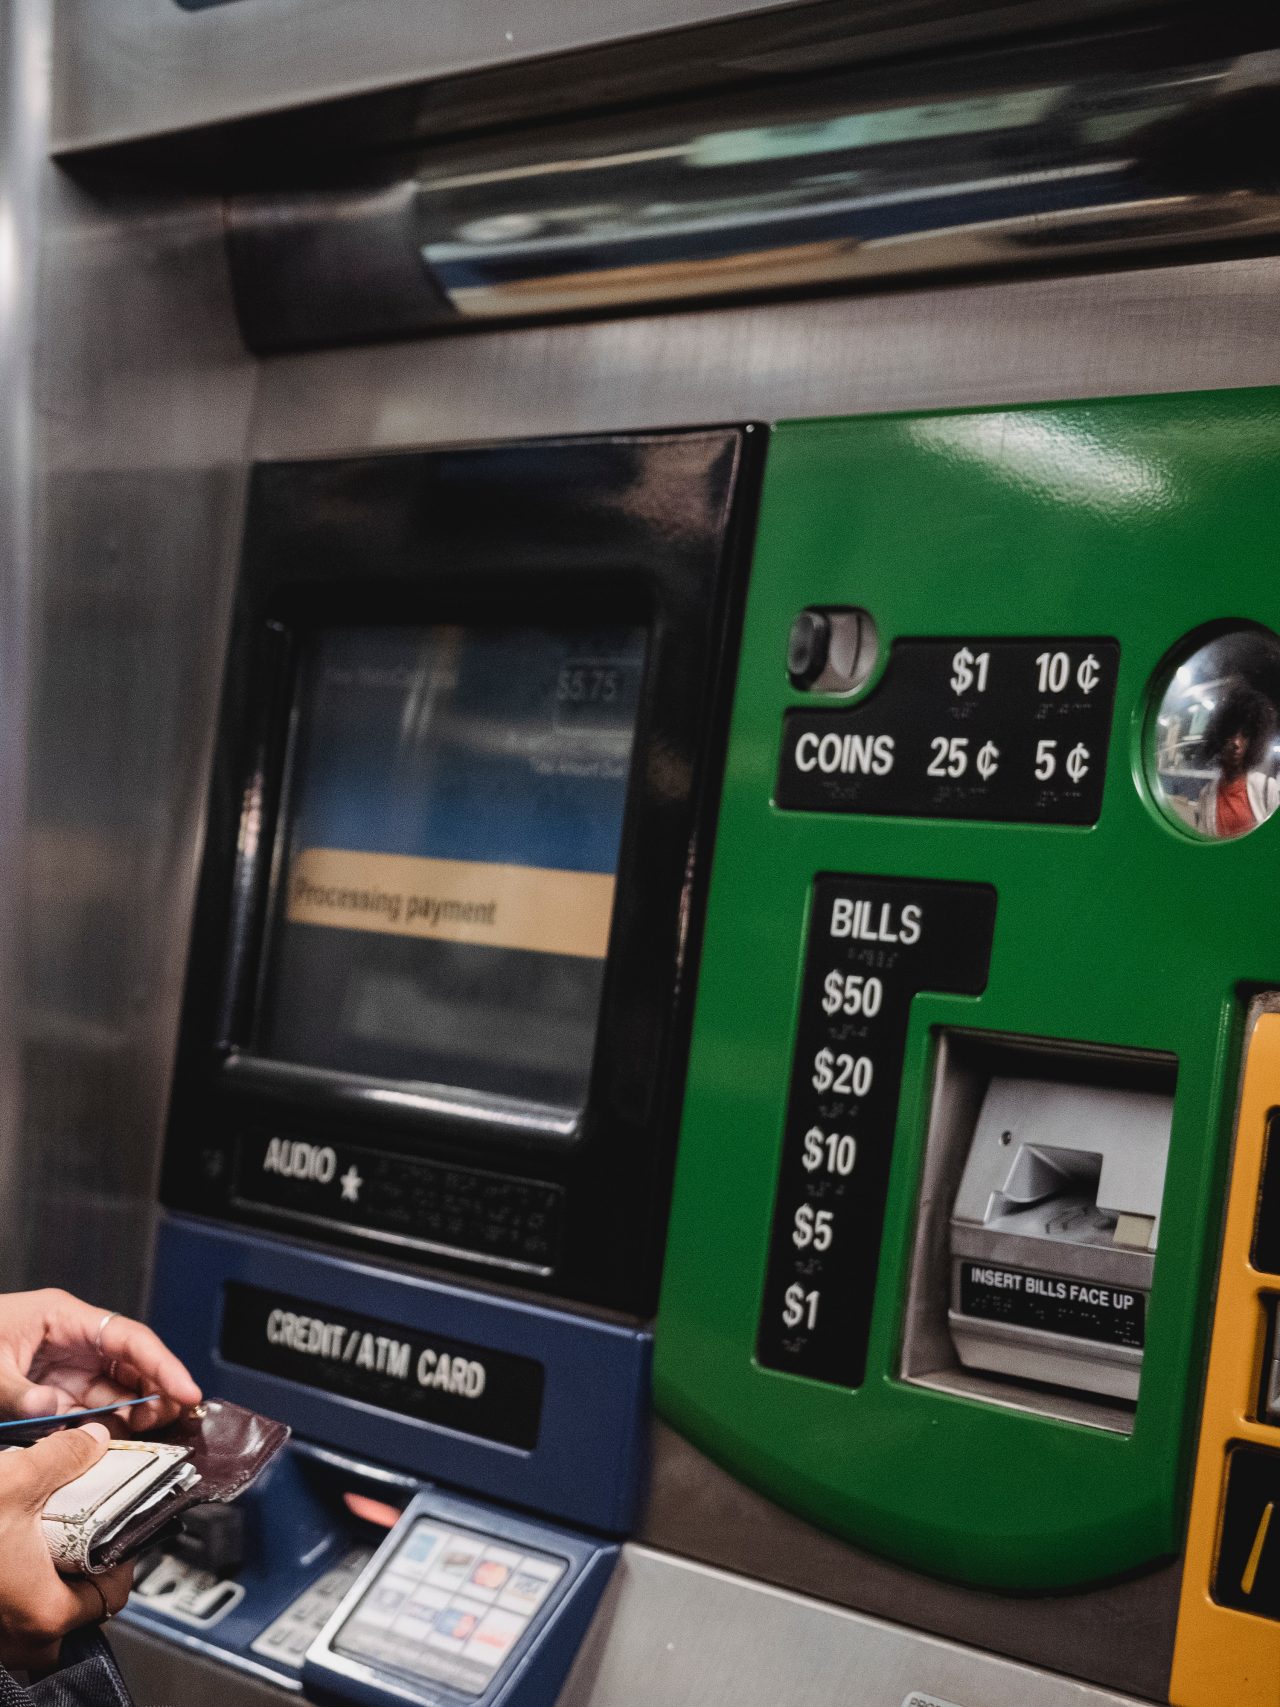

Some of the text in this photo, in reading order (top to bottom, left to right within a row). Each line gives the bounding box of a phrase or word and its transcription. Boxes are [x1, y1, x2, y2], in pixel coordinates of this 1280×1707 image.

[949, 645, 991, 697] $1
[1034, 650, 1071, 694] 10
[794, 731, 896, 777] COINS
[926, 735, 969, 779] 25
[1033, 738, 1058, 782] 5
[295, 876, 498, 928] Processing payment
[829, 897, 923, 946] BILLS
[820, 968, 883, 1019] $50
[811, 1046, 874, 1097] $20
[263, 1137, 337, 1183] AUDIO
[801, 1125, 857, 1176] $10
[792, 1203, 834, 1252] $5
[782, 1282, 820, 1331] $1
[971, 1267, 1134, 1310] INSERT BILLS FACE UP
[266, 1307, 487, 1399] CREDIT/ATM CARD
